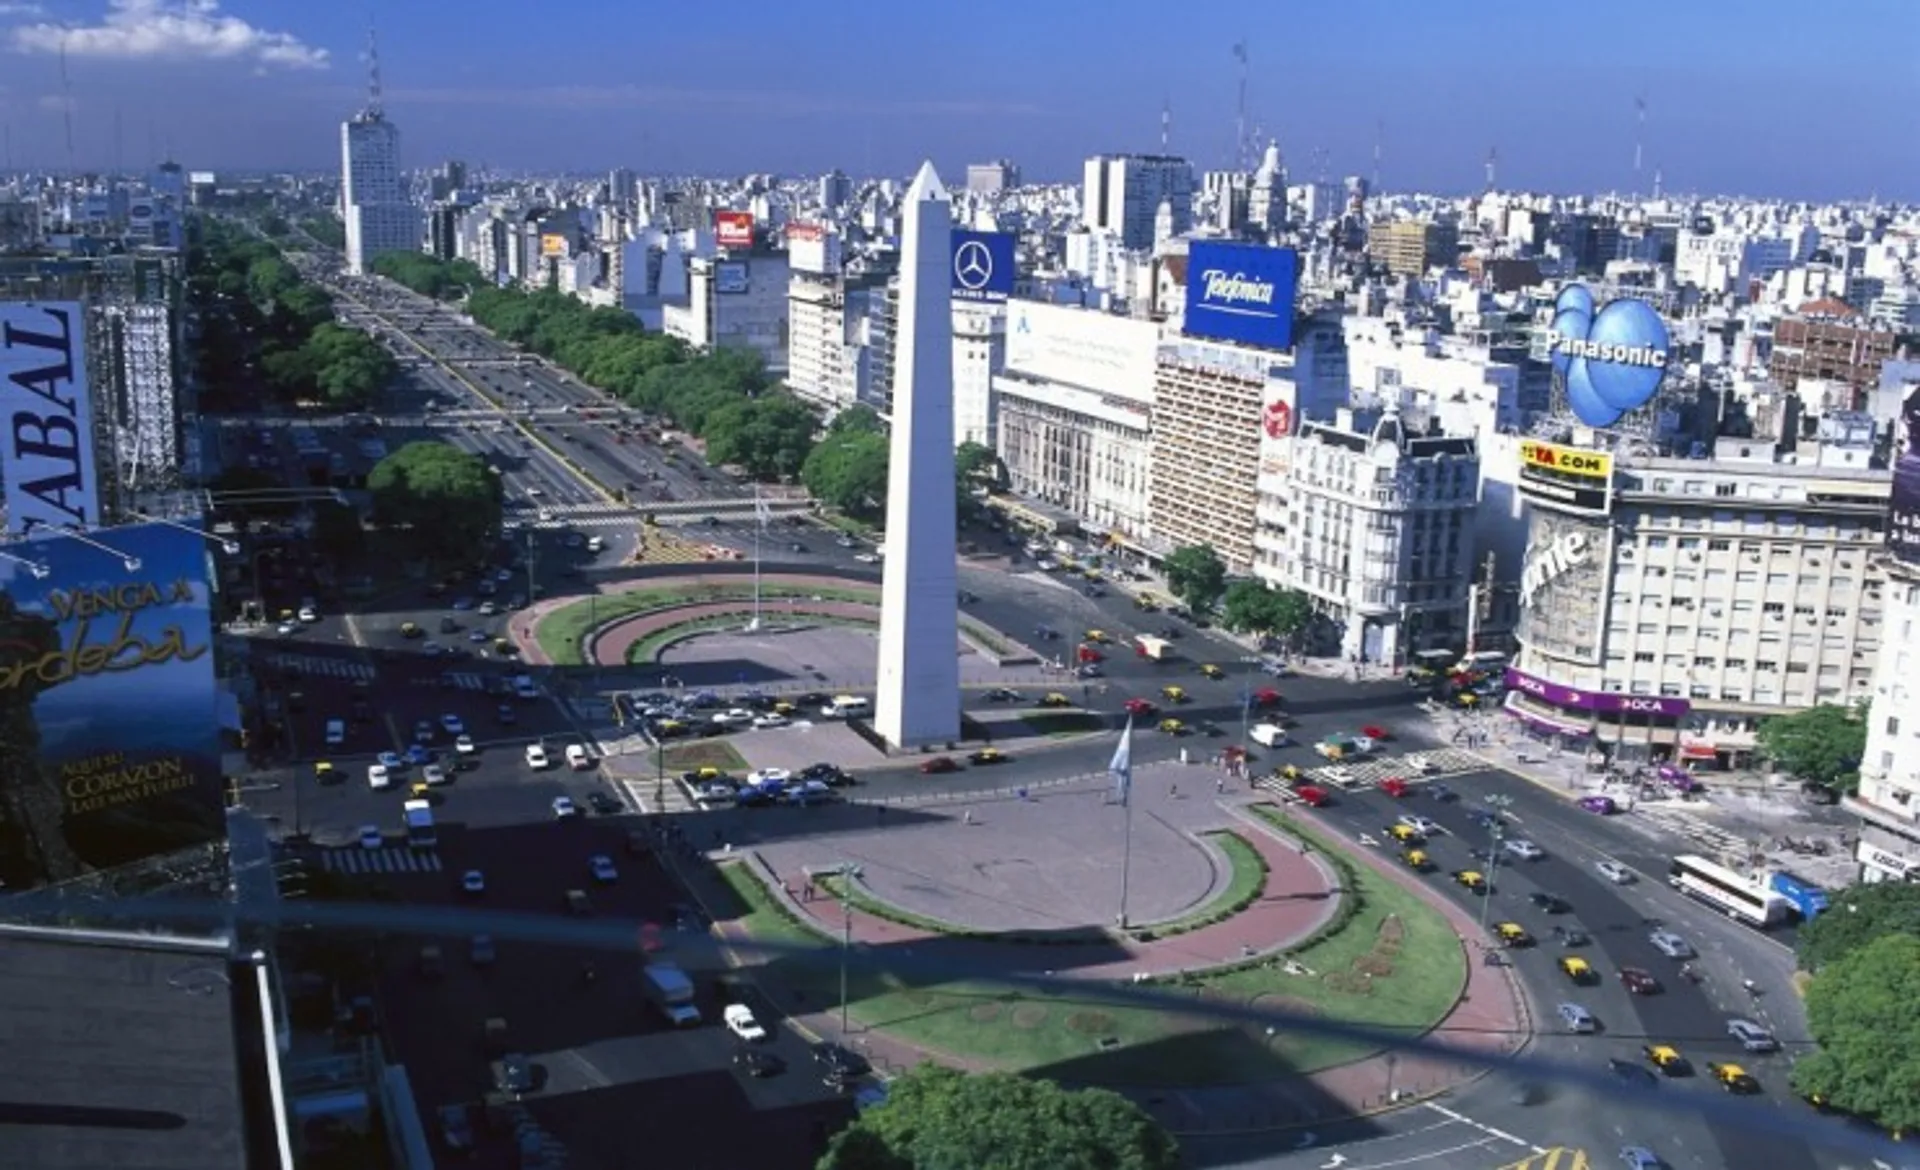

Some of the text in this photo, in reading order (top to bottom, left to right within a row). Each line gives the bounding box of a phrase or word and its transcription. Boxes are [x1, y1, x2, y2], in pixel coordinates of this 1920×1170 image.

[1546, 330, 1666, 367] Panasonic
[4, 307, 87, 534] ABAL
[51, 581, 161, 619] VENGA
[65, 756, 182, 799] CORAZON
